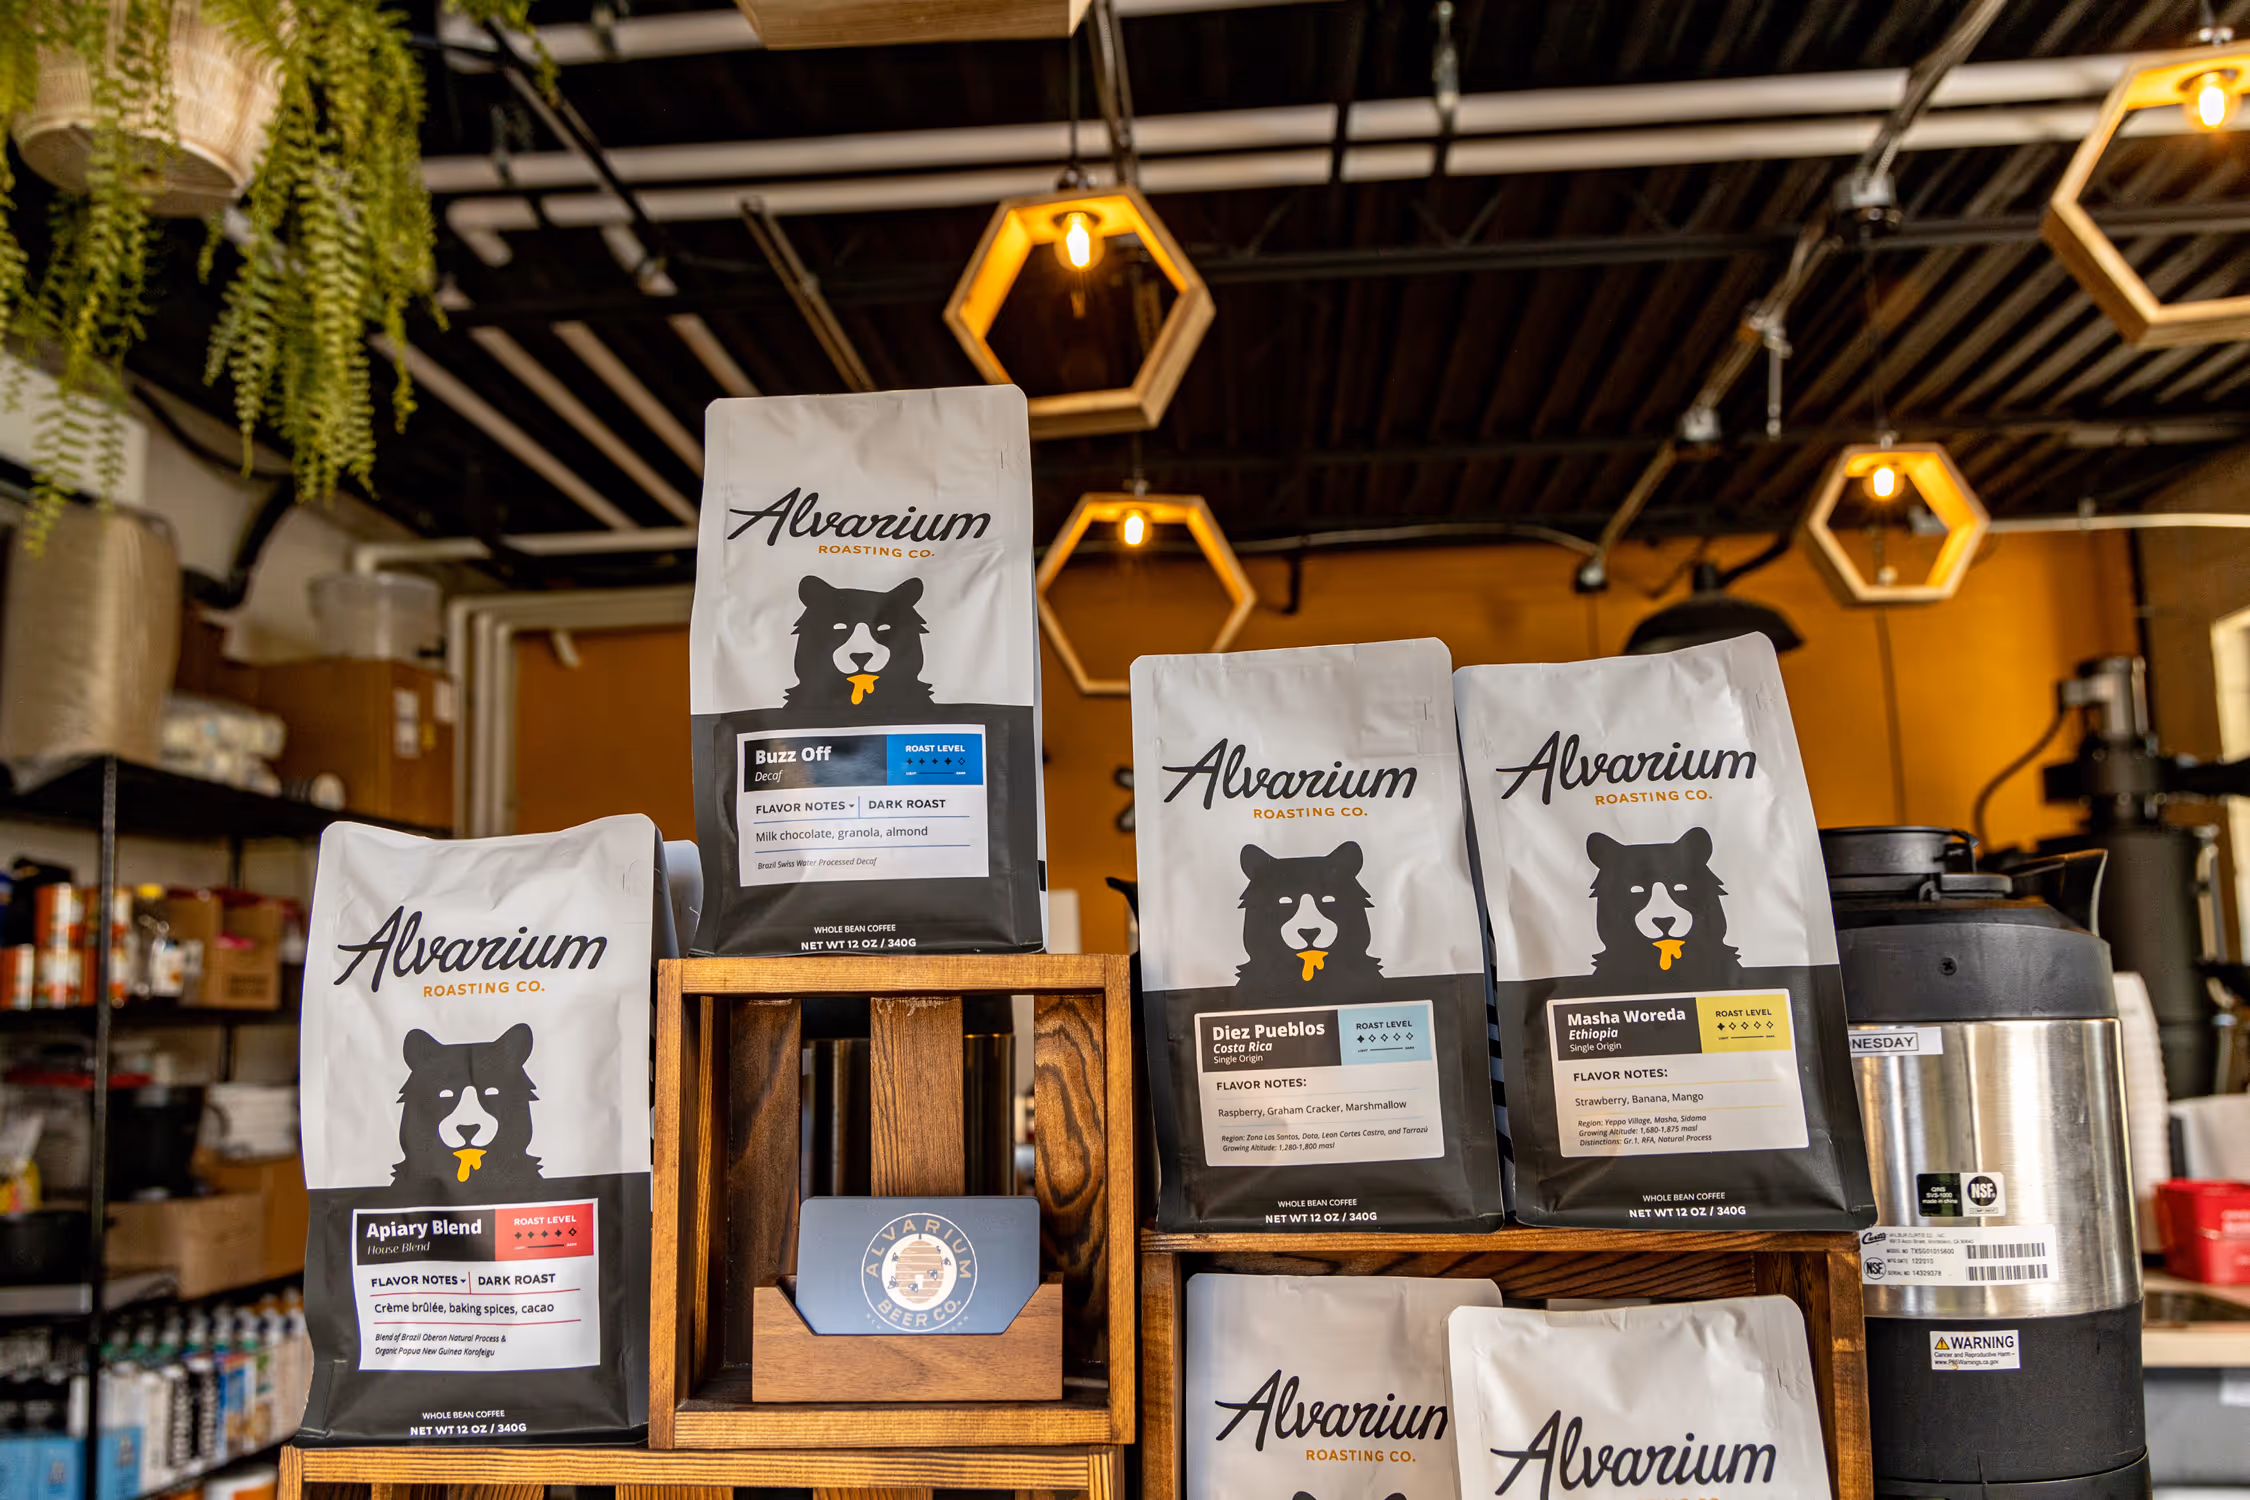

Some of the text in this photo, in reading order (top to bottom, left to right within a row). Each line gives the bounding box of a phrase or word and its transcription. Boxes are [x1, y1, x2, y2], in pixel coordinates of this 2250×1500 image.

[727, 487, 991, 546] Alvarium
[819, 545, 935, 558] ROASTING CO.
[755, 746, 832, 765] Buzz Off
[906, 745, 934, 753] ROAST
[1162, 738, 1417, 810] Alvarium
[1496, 731, 1757, 805] Alvarium
[755, 770, 783, 782] Decaf
[1595, 790, 1712, 805] ROASTING CO.
[756, 801, 845, 814] FLAVOR NOTES
[869, 800, 945, 809] DARK ROAST
[1254, 807, 1367, 819] ROASTING CO.
[756, 827, 927, 842] Milk chocolate, granola, almond
[758, 857, 877, 869] Brazil Swiss Water Processed Decaf
[844, 925, 865, 933] BEAN
[867, 924, 896, 932] COFFEE
[333, 905, 607, 993] Alvarium
[801, 938, 916, 950] NET WT 12 OZ 340G
[424, 980, 545, 997] ROASTING CO.
[1568, 1008, 1685, 1026] Masha Woreda
[1212, 1022, 1325, 1041] Diez Pueblos
[1356, 1020, 1412, 1030] ROAST LEVEL
[1569, 1028, 1618, 1042] Ethiopia
[1213, 1041, 1272, 1054] Costa Rica
[1570, 1042, 1621, 1053] Single Origin
[1850, 1037, 1913, 1048] NESDAY
[1213, 1054, 1263, 1064] Single Origin
[1573, 1068, 1668, 1082] FLAVOR NOTES:
[1216, 1078, 1307, 1091] FLAVOR NOTES:
[1575, 1093, 1704, 1106] Strawberry, Banana, Mango
[1218, 1100, 1407, 1118] Raspberry, Graham Cracker, Marshmallow
[1605, 1119, 1626, 1127] Yeppo
[1628, 1117, 1652, 1125] Village,
[1222, 1134, 1245, 1143] Region:
[1276, 1133, 1300, 1141] Santos,
[1322, 1131, 1337, 1139] Leon
[1339, 1130, 1361, 1138] Cortes
[1362, 1129, 1386, 1137] Castro,
[1579, 1129, 1607, 1138] Growing
[1609, 1128, 1638, 1136] Altitude:
[1640, 1126, 1679, 1134] 1,680-1,875
[1580, 1138, 1622, 1146] Distinctions:
[1658, 1134, 1684, 1143] Natural
[1223, 1144, 1248, 1153] Growing
[1279, 1143, 1317, 1151] 1,280-1,800
[1643, 1194, 1671, 1202] WHOLE
[1696, 1192, 1725, 1200] COFFEE
[1971, 1183, 1993, 1198] NSF
[1266, 1212, 1377, 1223] NET WT 12 OZ 340G
[1629, 1206, 1746, 1217] NET WT 12 OZ 340G
[514, 1215, 576, 1226] ROAST LEVEL
[366, 1219, 482, 1241] Apiary Blend
[368, 1242, 430, 1255] House Blend
[866, 1219, 971, 1278] ALVARIUM
[1867, 1262, 1883, 1275] NSF
[371, 1275, 458, 1287] FLAVOR NOTES
[478, 1274, 555, 1286] DARK ROAST
[375, 1302, 554, 1316] Crème brûlée, baking spices, cacao
[877, 1300, 927, 1327] BEER
[401, 1334, 499, 1343] Brazil Oberon Natural Process
[1950, 1336, 2014, 1349] WARNING
[375, 1347, 397, 1356] Organic
[400, 1348, 421, 1357] Papua
[464, 1348, 494, 1358] Korofeigu
[476, 1410, 505, 1418] COFFEE
[410, 1423, 527, 1435] NET WT 12 OZ 340G
[1306, 1449, 1416, 1462] ROASTING CO.
[1490, 1410, 1776, 1500] Alvarium
